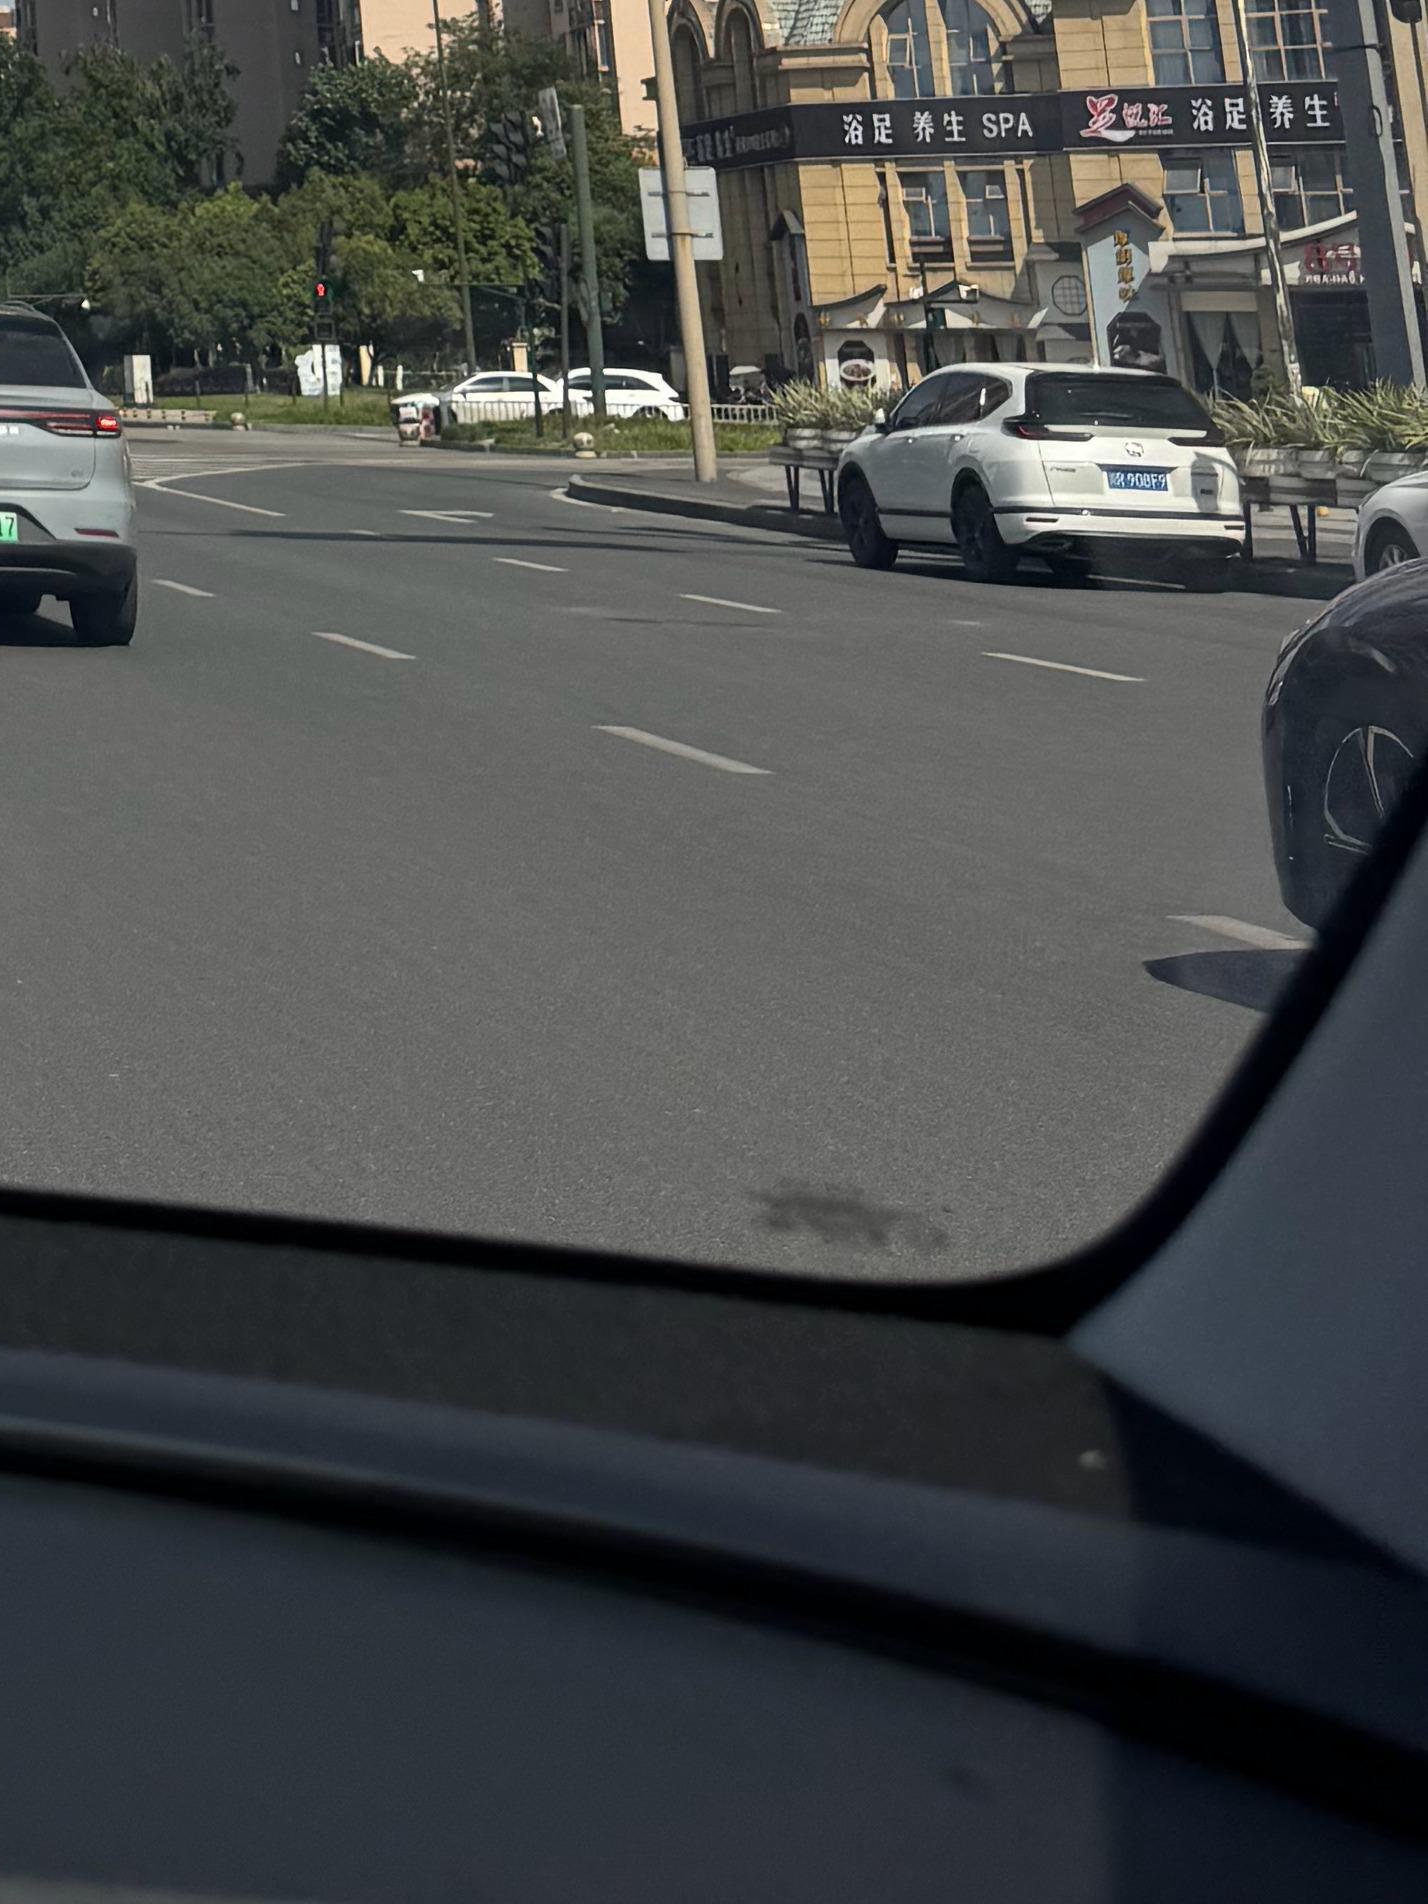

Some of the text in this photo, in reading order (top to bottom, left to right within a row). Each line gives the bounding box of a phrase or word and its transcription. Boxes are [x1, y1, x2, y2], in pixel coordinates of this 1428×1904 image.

[842, 110, 1034, 145] 浴足 养生 SPA
[1190, 94, 1331, 132] 浴足 养生
